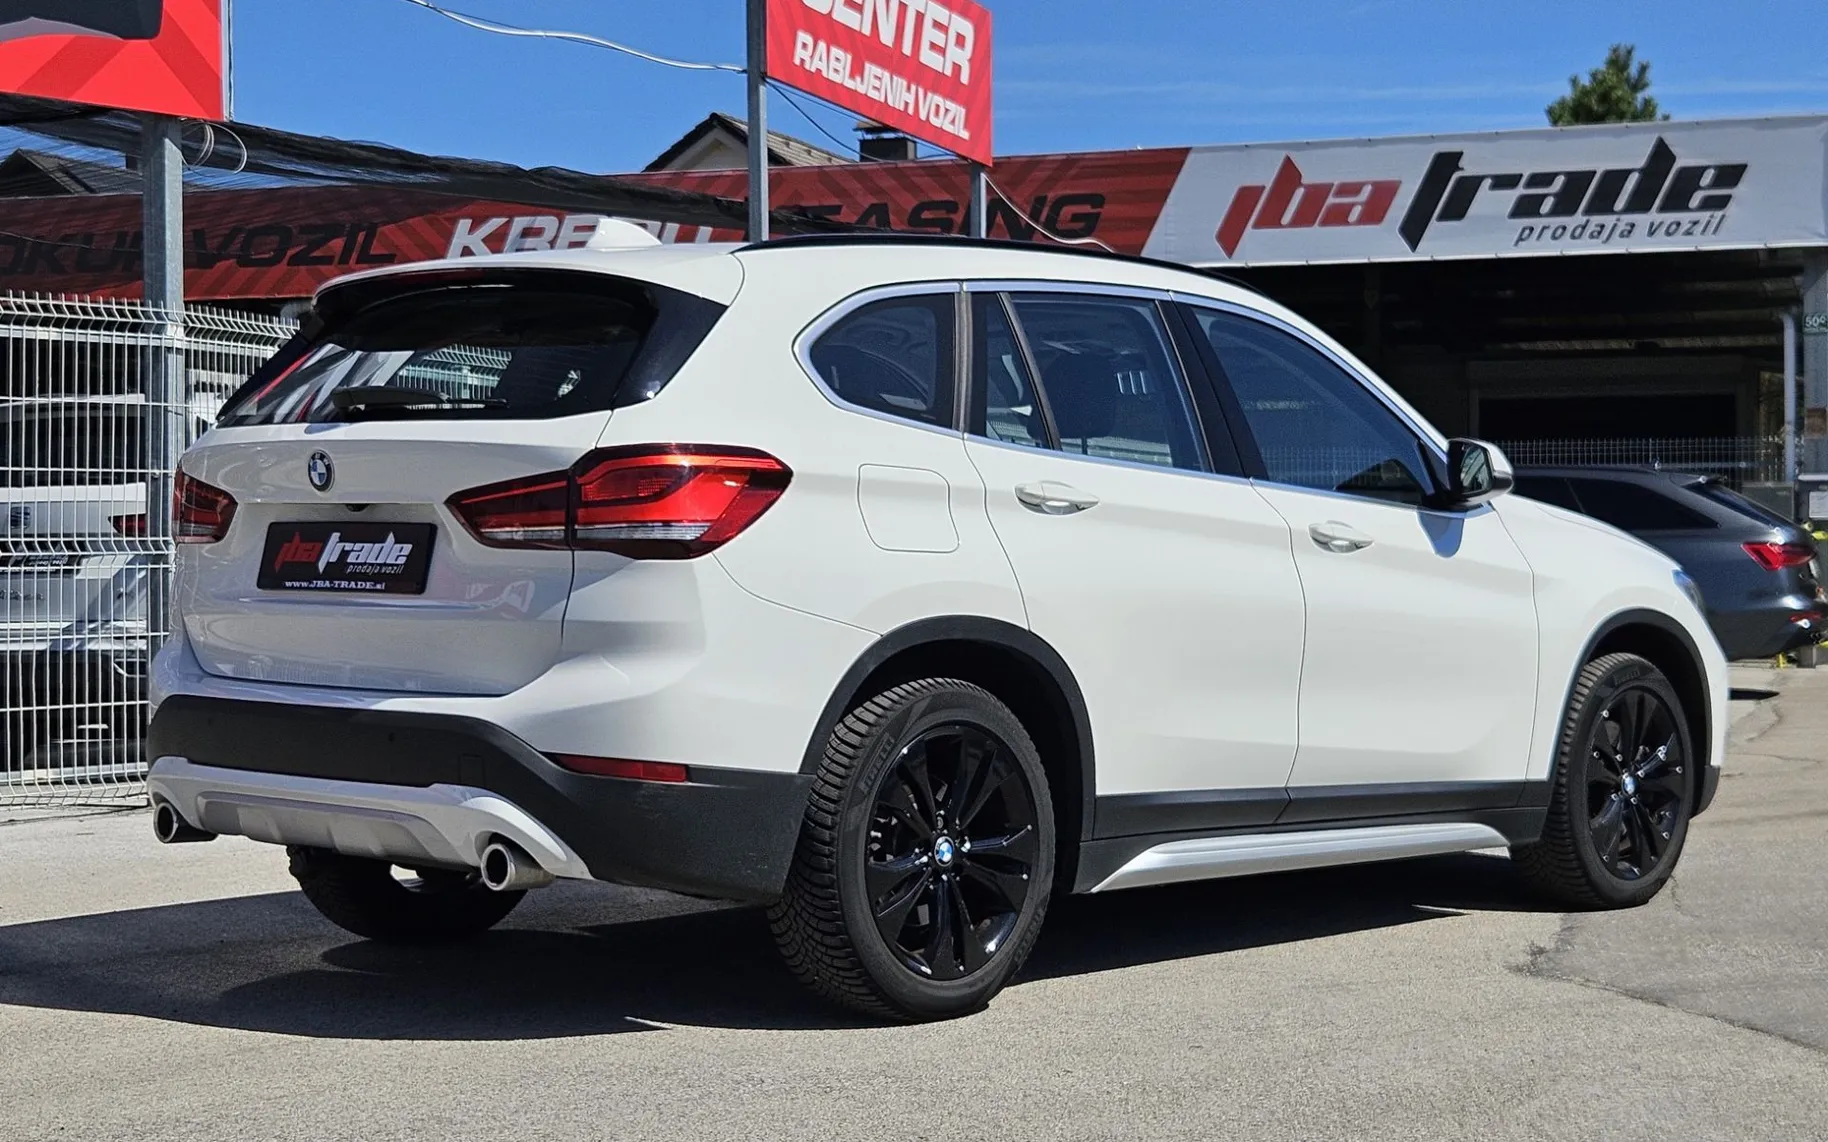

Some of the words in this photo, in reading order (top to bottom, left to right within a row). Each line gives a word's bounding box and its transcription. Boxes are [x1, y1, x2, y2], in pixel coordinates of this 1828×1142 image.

[803, 0, 975, 85] NTER
[793, 31, 917, 115] RABLJENIH
[917, 84, 970, 140] VOZIL
[190, 221, 397, 270] VOZIL
[1514, 217, 1636, 247] prodaja
[1646, 213, 1726, 238] vozil
[318, 531, 413, 575] trade
[346, 564, 380, 576] prodaja
[381, 565, 404, 574] vozil
